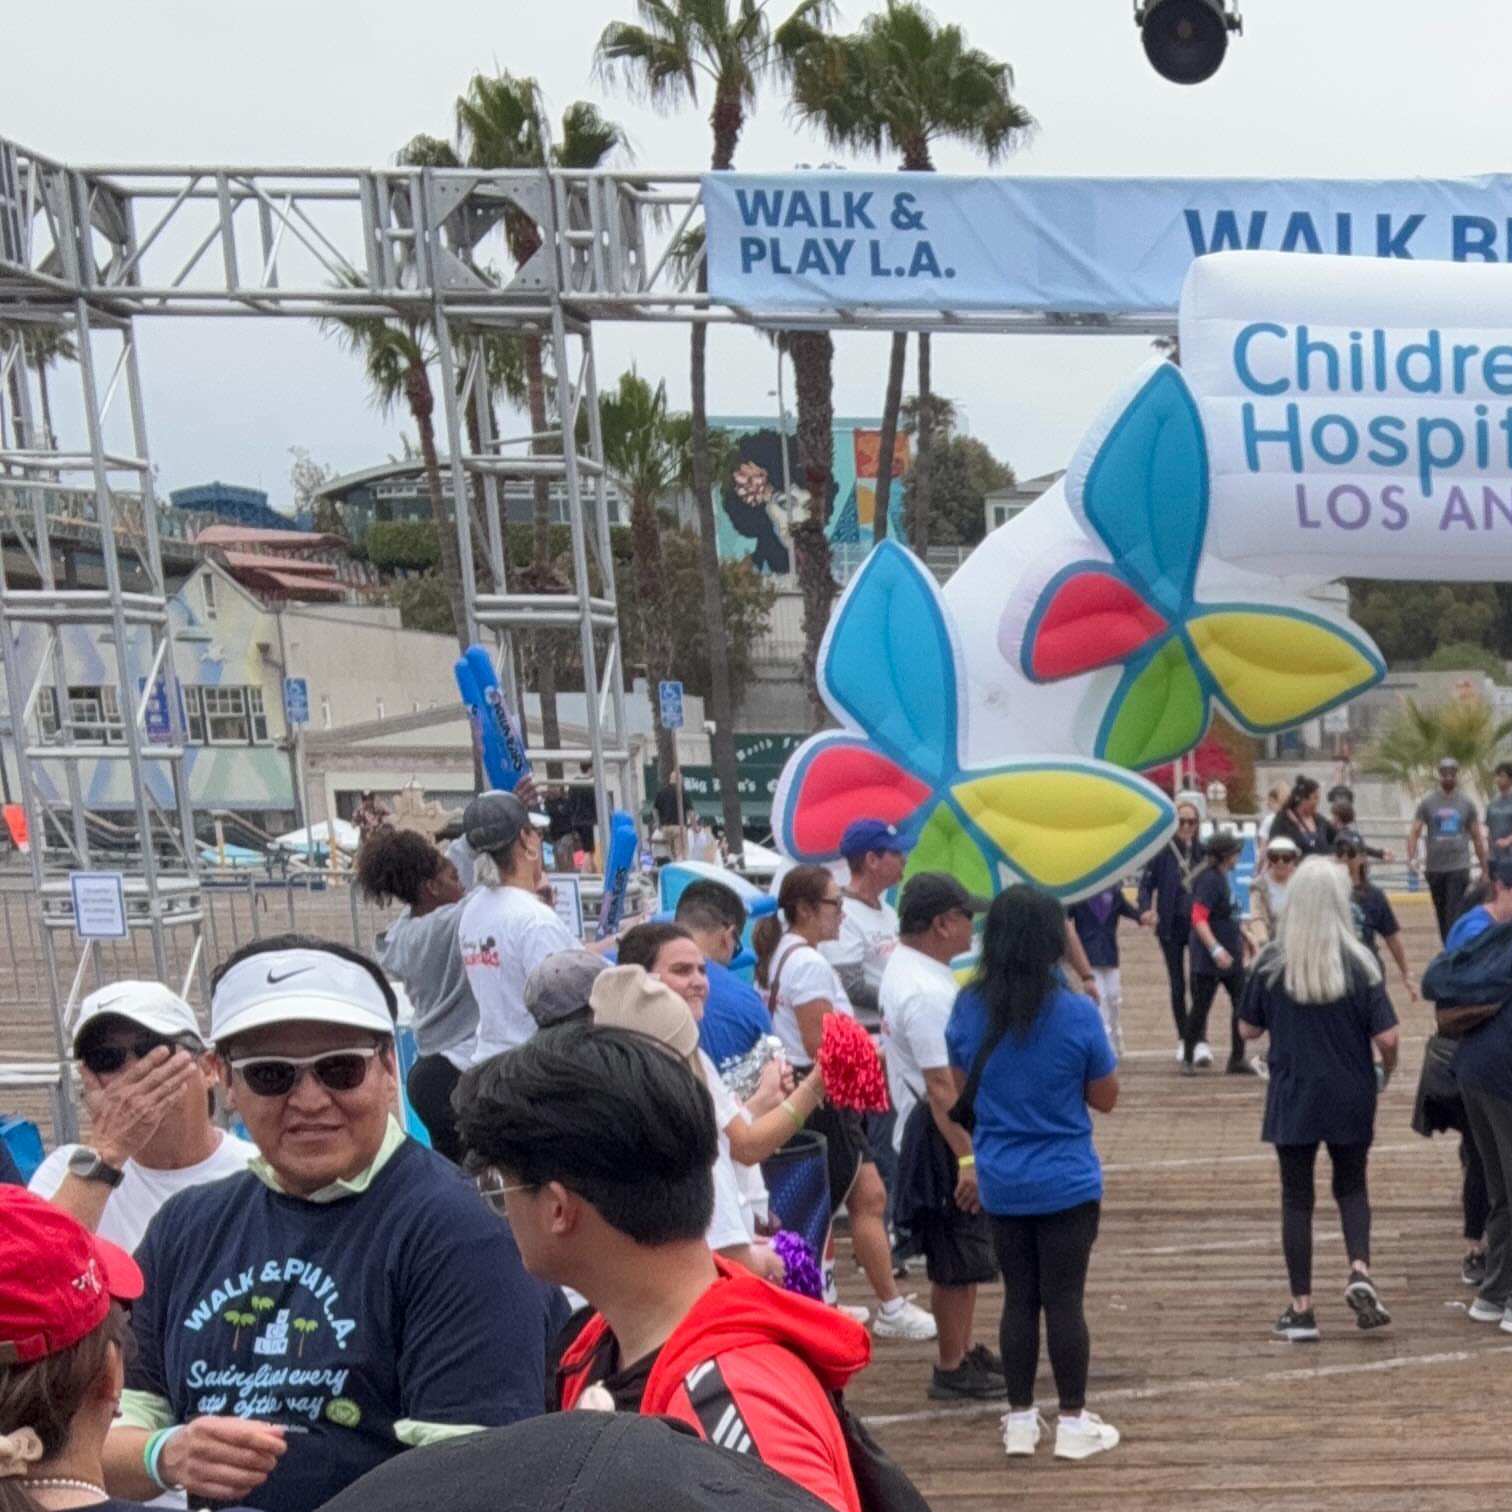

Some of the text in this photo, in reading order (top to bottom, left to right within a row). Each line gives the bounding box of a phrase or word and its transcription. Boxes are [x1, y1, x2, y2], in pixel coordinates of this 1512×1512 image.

[734, 188, 927, 231] WALK &
[1183, 208, 1427, 260] WALK
[740, 237, 957, 279] PLAY L.A.
[1296, 483, 1408, 531] LOS
[184, 1266, 254, 1331] WALK
[260, 1260, 281, 1282] &
[284, 1258, 335, 1299] PLAY
[323, 1291, 357, 1349] L.A.
[290, 1369, 350, 1397] every
